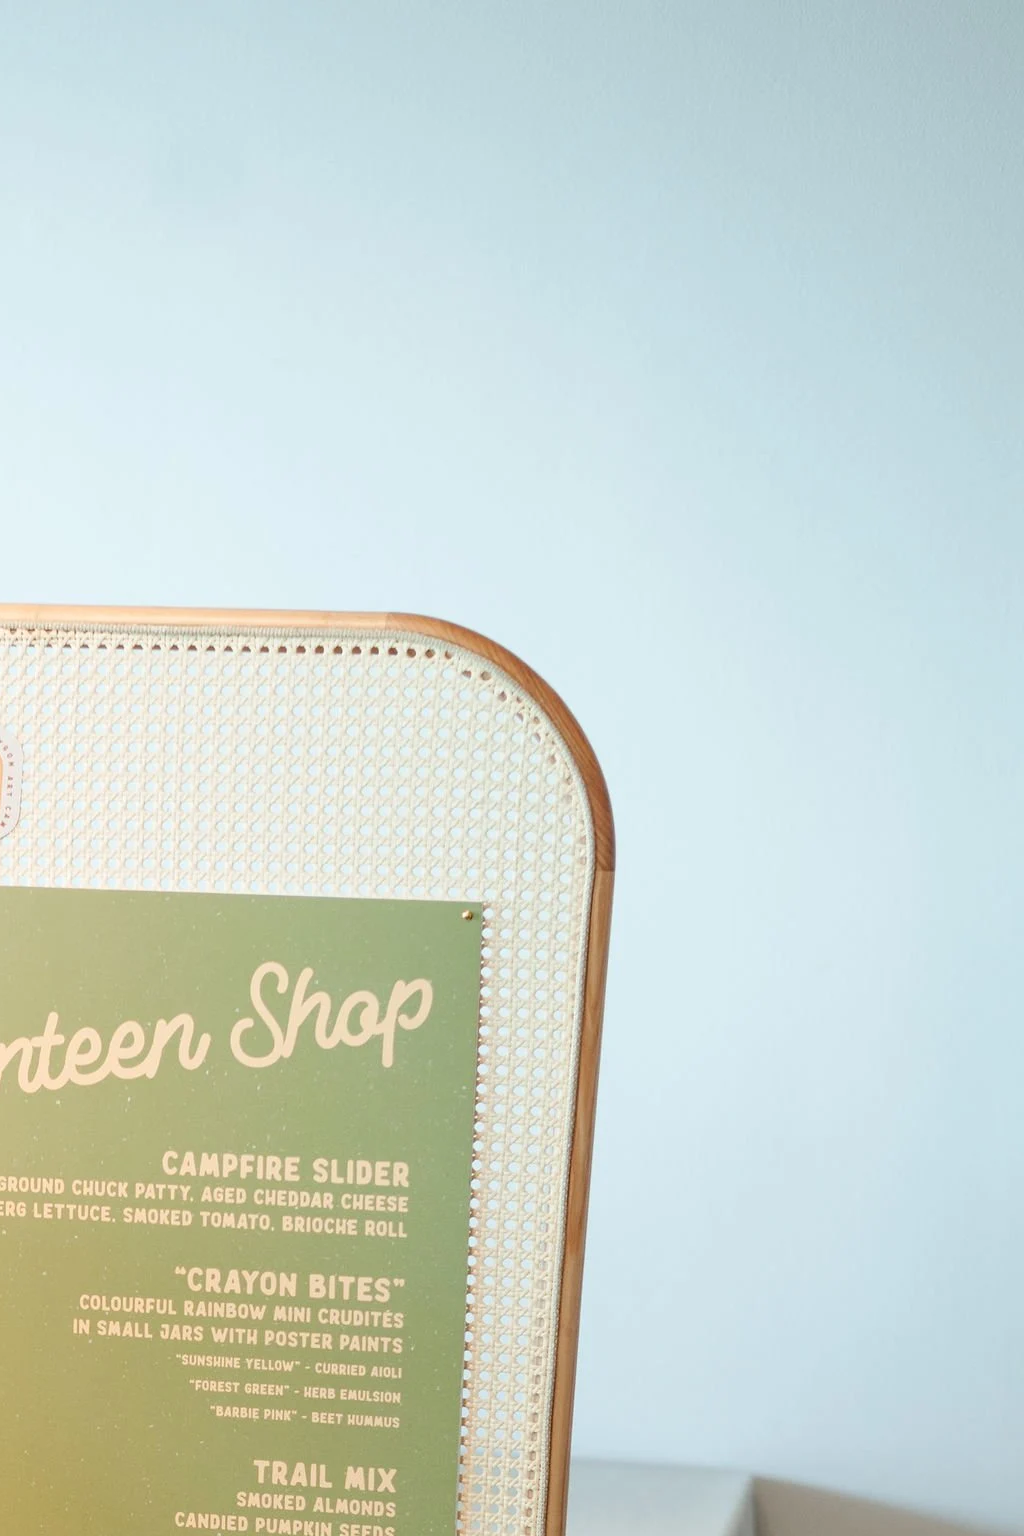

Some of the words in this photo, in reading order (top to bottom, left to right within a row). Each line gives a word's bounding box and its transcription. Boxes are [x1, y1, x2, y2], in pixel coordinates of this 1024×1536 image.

[230, 961, 434, 1068] Shop
[162, 1150, 301, 1181] CAMPFIRE
[312, 1158, 409, 1188] SLIDER
[71, 1180, 128, 1198] CHUCK
[201, 1186, 247, 1204] AGED
[253, 1189, 334, 1210] CHEDDAR
[341, 1193, 409, 1213] CHEESE
[123, 1207, 192, 1226] SMOKED
[282, 1216, 358, 1235] BRIOCHE
[364, 1219, 407, 1238] ROLL
[79, 1294, 177, 1315] COLOURFUL
[183, 1300, 266, 1320] RAINBOW
[273, 1305, 311, 1323] MINI
[318, 1308, 404, 1329] CRUDITÉS
[73, 1318, 90, 1335] IN
[97, 1319, 153, 1339] SMALL
[159, 1324, 204, 1342] JARS
[210, 1327, 258, 1345] WITH
[264, 1330, 333, 1350] POSTER
[339, 1334, 404, 1354] PAINTS
[315, 1362, 366, 1377] CURRIED
[371, 1366, 403, 1379] AIOLI
[304, 1387, 336, 1400] HERB
[340, 1389, 401, 1404] EMULSION
[311, 1412, 343, 1425] BEET
[347, 1414, 400, 1428] HUMMUS
[253, 1459, 333, 1488] TRAIL
[344, 1466, 397, 1493] MIX
[236, 1491, 306, 1511] SMOKED
[313, 1497, 397, 1518] ALMONDS
[175, 1511, 248, 1531] CANDIED
